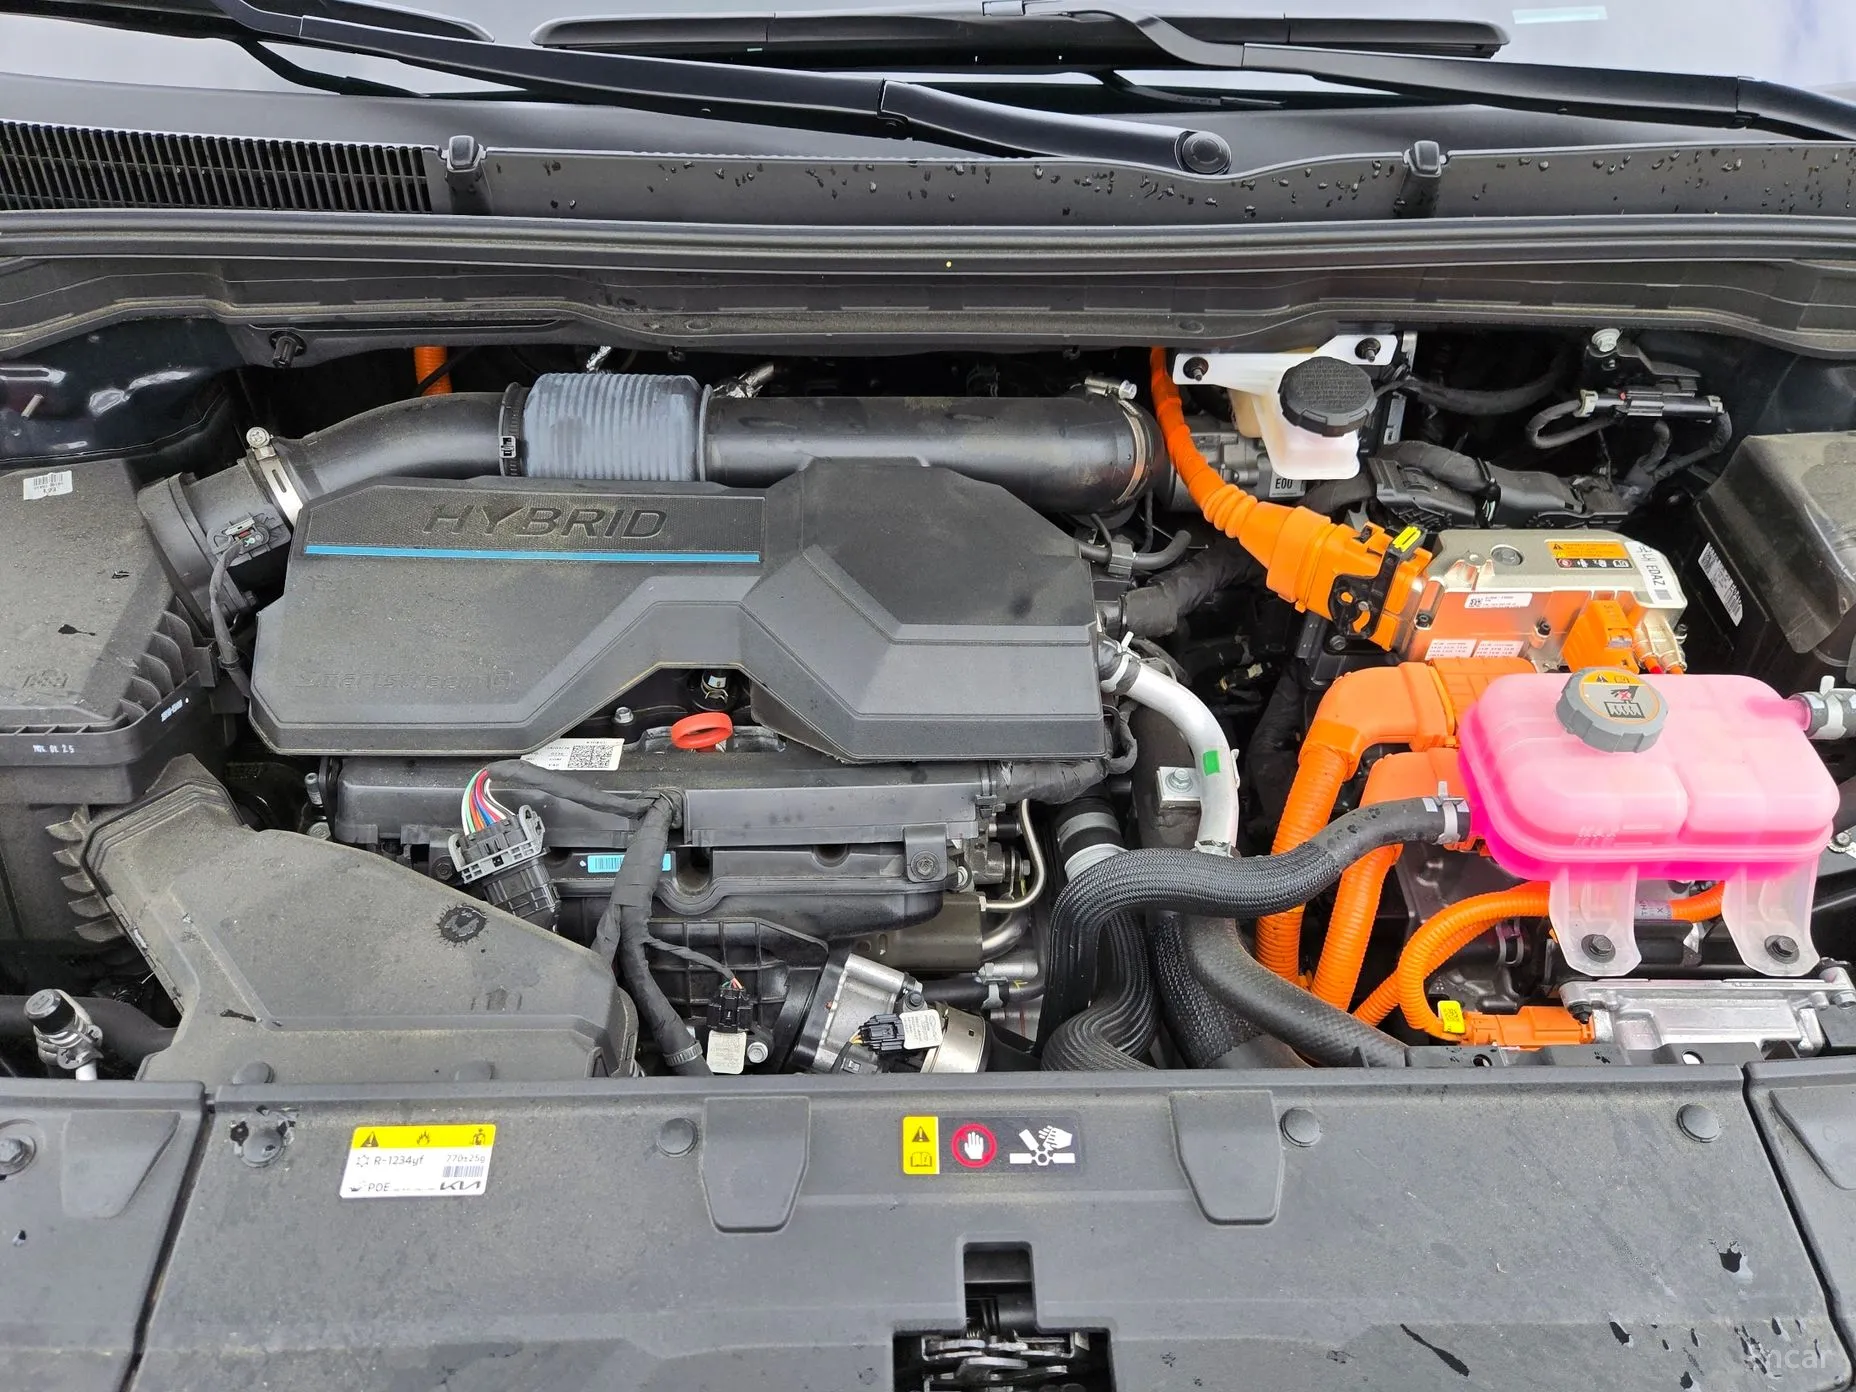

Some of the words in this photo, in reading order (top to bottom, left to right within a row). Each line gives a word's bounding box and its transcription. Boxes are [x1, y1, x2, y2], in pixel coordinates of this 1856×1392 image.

[422, 504, 669, 539] HYBRID
[373, 1154, 425, 1167] R-1234yf
[367, 1182, 391, 1192] POE
